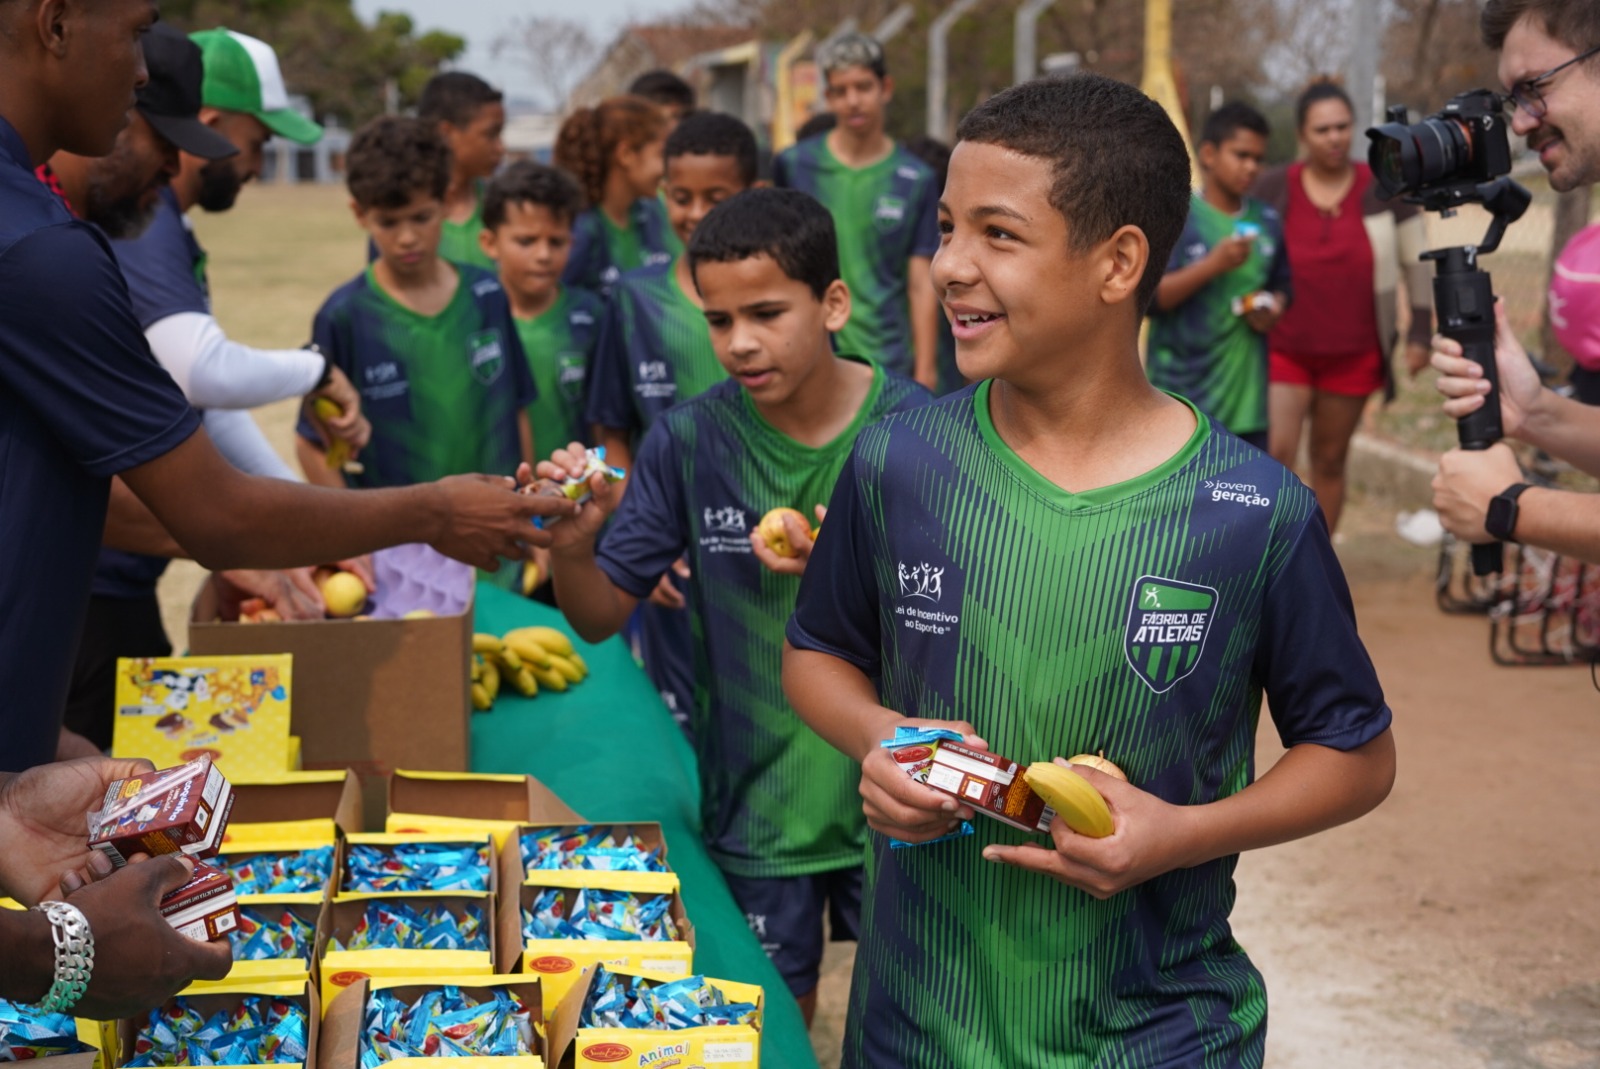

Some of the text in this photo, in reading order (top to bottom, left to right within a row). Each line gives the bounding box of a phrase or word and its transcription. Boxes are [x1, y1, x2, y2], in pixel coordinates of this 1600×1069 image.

[1214, 480, 1257, 493] jovem
[1211, 489, 1270, 507] geração
[906, 606, 917, 617] de
[917, 608, 959, 624] Incentivo
[1141, 611, 1208, 625] FÁBRICA DE
[904, 619, 915, 628] ao
[915, 620, 945, 635] Esporte
[1132, 625, 1204, 643] ATLETAS
[168, 780, 193, 822] coquinha
[639, 1042, 689, 1067] Animal
